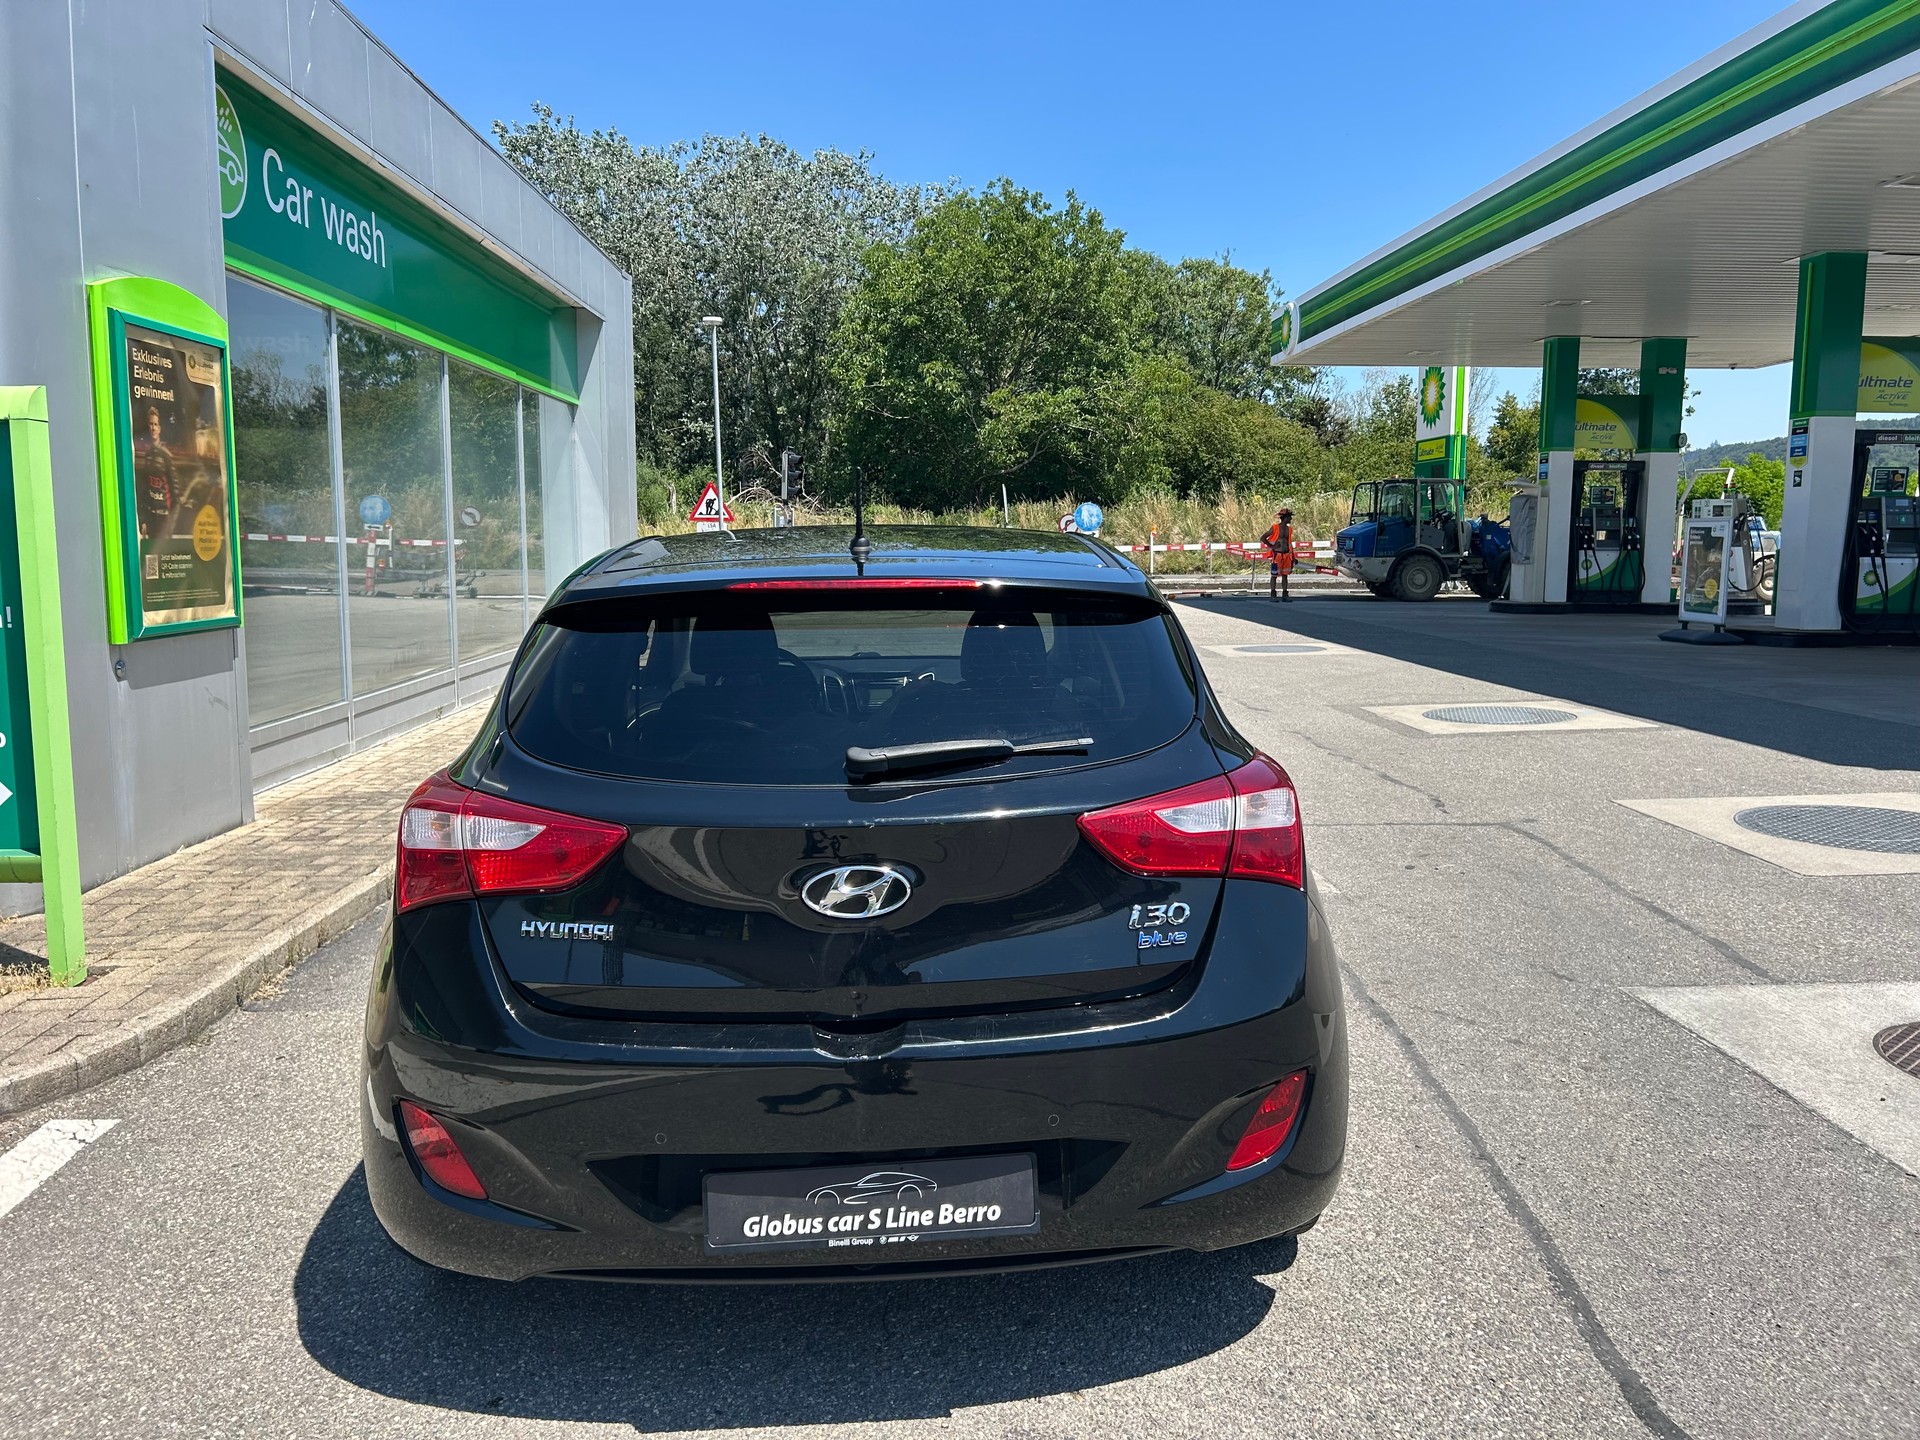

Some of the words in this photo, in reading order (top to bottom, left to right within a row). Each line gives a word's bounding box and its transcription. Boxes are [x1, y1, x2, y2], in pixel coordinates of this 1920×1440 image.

[263, 148, 313, 229] Car
[320, 196, 386, 268] wash
[132, 347, 173, 369] Exklusives
[133, 365, 165, 384] Erlebnis
[134, 385, 175, 402] gewinnen!
[1574, 422, 1617, 432] ultimate
[1129, 902, 1191, 930] i30
[521, 921, 614, 940] HYUNDAI
[1138, 930, 1188, 948] blue
[743, 1213, 824, 1237] Globus
[827, 1214, 865, 1232] car
[867, 1208, 882, 1230] S
[885, 1206, 934, 1228] Line
[938, 1203, 1001, 1225] Berro
[828, 1239, 850, 1247] Binelli
[851, 1238, 874, 1247] Group
